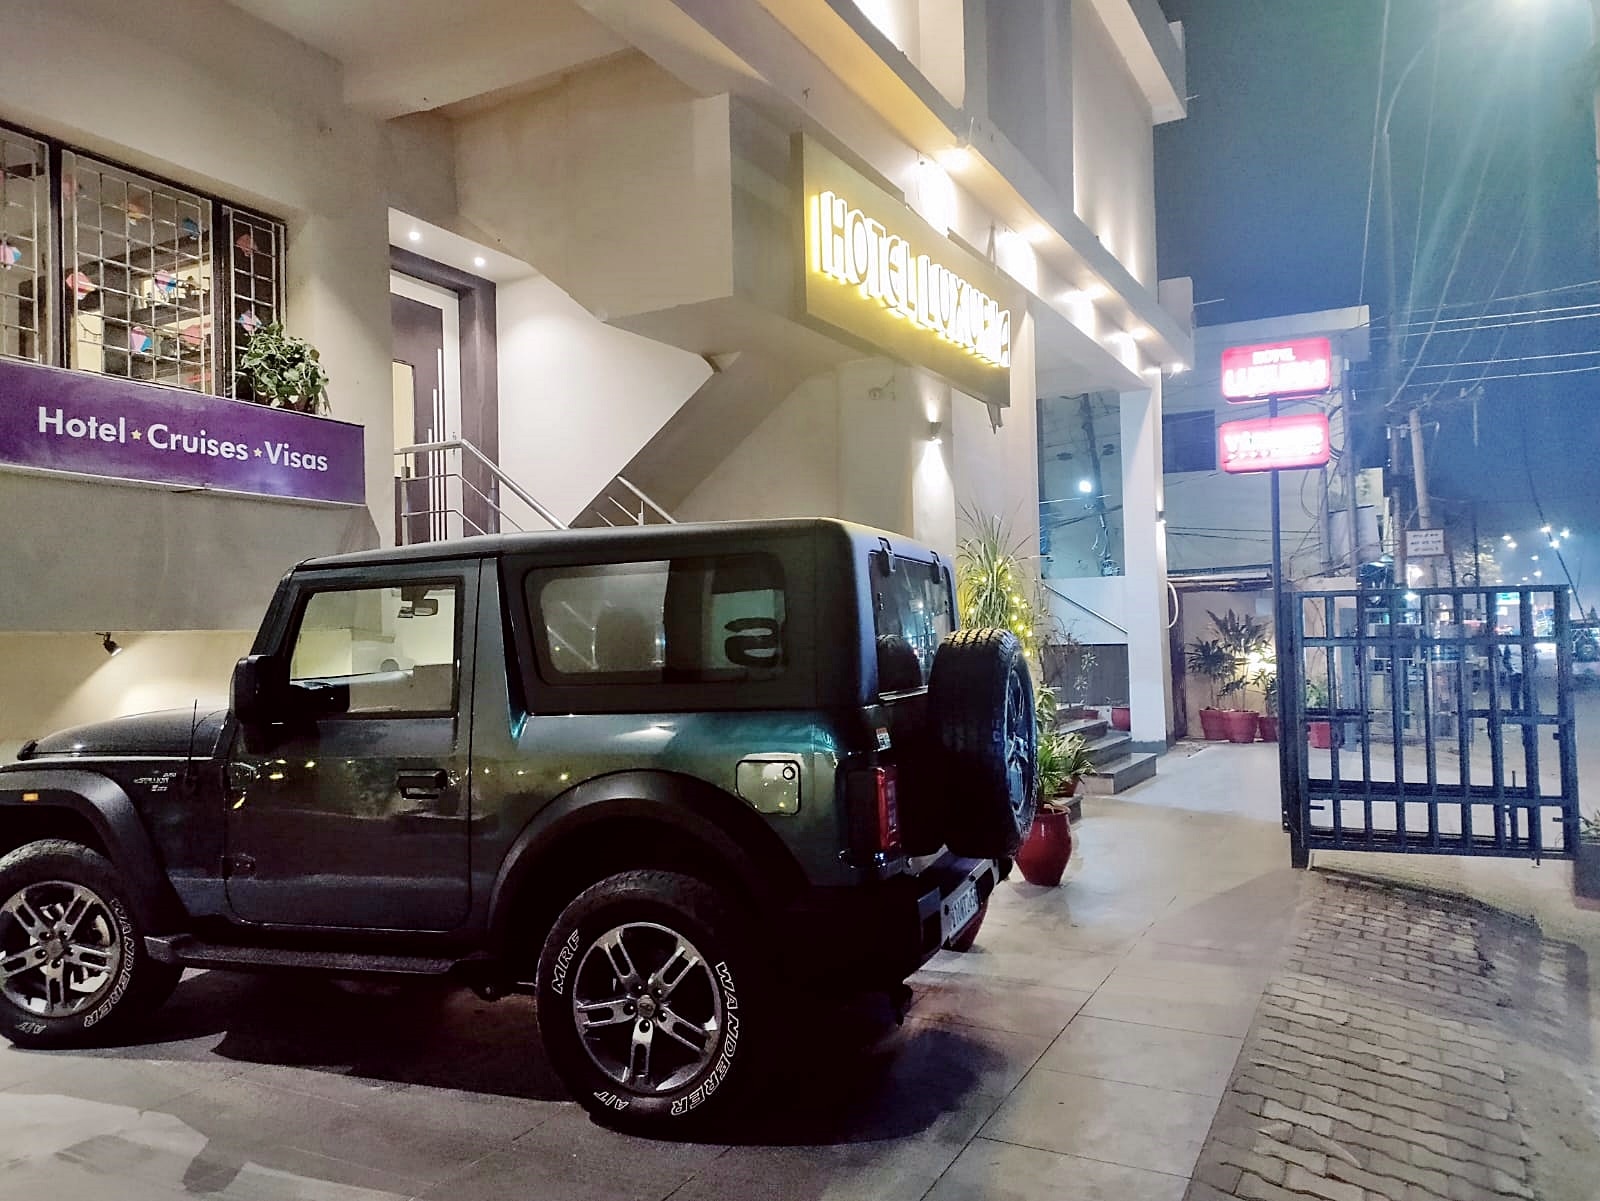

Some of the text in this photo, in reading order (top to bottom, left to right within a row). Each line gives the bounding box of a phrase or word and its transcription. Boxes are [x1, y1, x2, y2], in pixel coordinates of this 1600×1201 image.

[812, 191, 917, 321] HOTEL
[38, 406, 328, 472] Hotel Cruises Visas
[551, 929, 580, 994] MRF
[671, 961, 739, 1115] WANDERER
